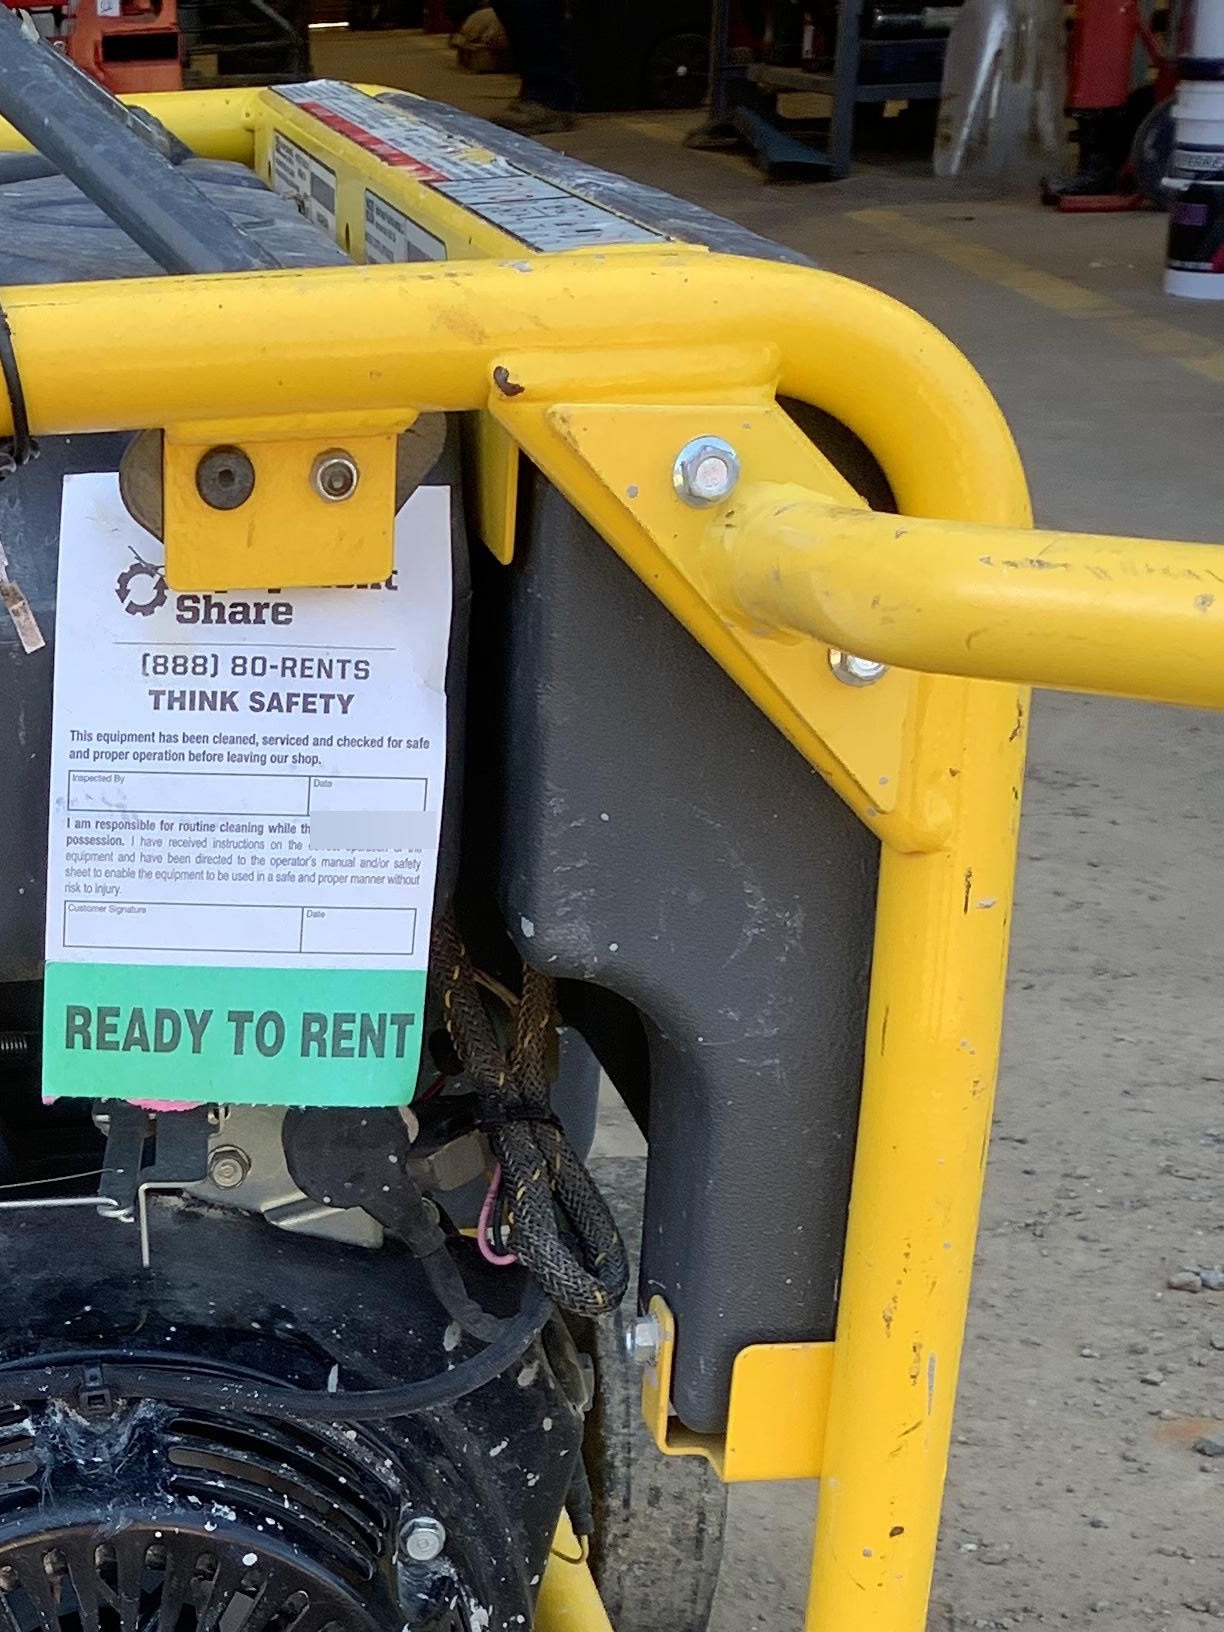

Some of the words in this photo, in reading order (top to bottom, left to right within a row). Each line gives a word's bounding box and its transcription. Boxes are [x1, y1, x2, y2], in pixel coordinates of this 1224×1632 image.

[176, 594, 293, 625] Share
[142, 653, 219, 678] (888)
[231, 655, 370, 680] 80-RENTS
[149, 690, 239, 712] THINK
[249, 692, 355, 714] SAFETY
[70, 730, 93, 742] This
[97, 731, 155, 746] equipment
[159, 732, 179, 744] has
[182, 732, 209, 745] been
[212, 733, 259, 747] cleaned,
[262, 734, 309, 747] serviced
[313, 735, 333, 747] and
[337, 736, 384, 748] checked
[387, 736, 403, 749] for
[406, 737, 430, 750] safe
[69, 748, 90, 760] and
[93, 750, 130, 762] proper
[132, 749, 185, 763] operation
[188, 750, 224, 763] before
[227, 751, 267, 765] leaving
[270, 753, 289, 764] our
[291, 753, 322, 767] shop.
[72, 774, 112, 783] Inspected
[114, 774, 126, 784] By
[67, 818, 71, 829] I
[75, 820, 91, 829] am
[95, 819, 156, 832] responsible
[160, 820, 175, 832] for
[179, 821, 216, 833] routine
[219, 821, 264, 835] cleaning
[268, 823, 297, 835] while
[301, 824, 311, 835] th
[66, 835, 125, 847] possession.
[131, 836, 135, 846] I
[140, 836, 163, 847] have
[168, 837, 208, 848] received
[212, 838, 265, 850] instructions
[270, 841, 282, 850] on
[288, 839, 303, 850] the
[65, 851, 114, 864] equipment
[118, 852, 135, 863] and
[140, 852, 163, 863] have
[167, 853, 191, 864] been
[195, 854, 233, 865] directed
[238, 856, 246, 865] to
[250, 855, 266, 866] the
[270, 856, 317, 869] operator's
[321, 857, 356, 868] manual
[360, 857, 390, 868] and/or
[393, 858, 422, 872] safety
[65, 866, 91, 878] sheet
[93, 868, 102, 878] to
[104, 868, 136, 879] enable
[138, 868, 153, 880] the
[155, 869, 204, 882] equipment
[206, 870, 215, 881] to
[217, 870, 229, 881] be
[231, 870, 255, 882] used
[257, 871, 265, 882] in
[267, 874, 274, 883] a
[276, 871, 296, 883] safe
[298, 872, 316, 884] and
[318, 874, 348, 886] proper
[350, 875, 385, 885] manner
[387, 874, 420, 885] without
[65, 882, 81, 893] risk
[83, 884, 93, 894] to
[65, 1005, 213, 1055] READY
[227, 1010, 286, 1058] TO
[300, 1012, 416, 1059] RENT
